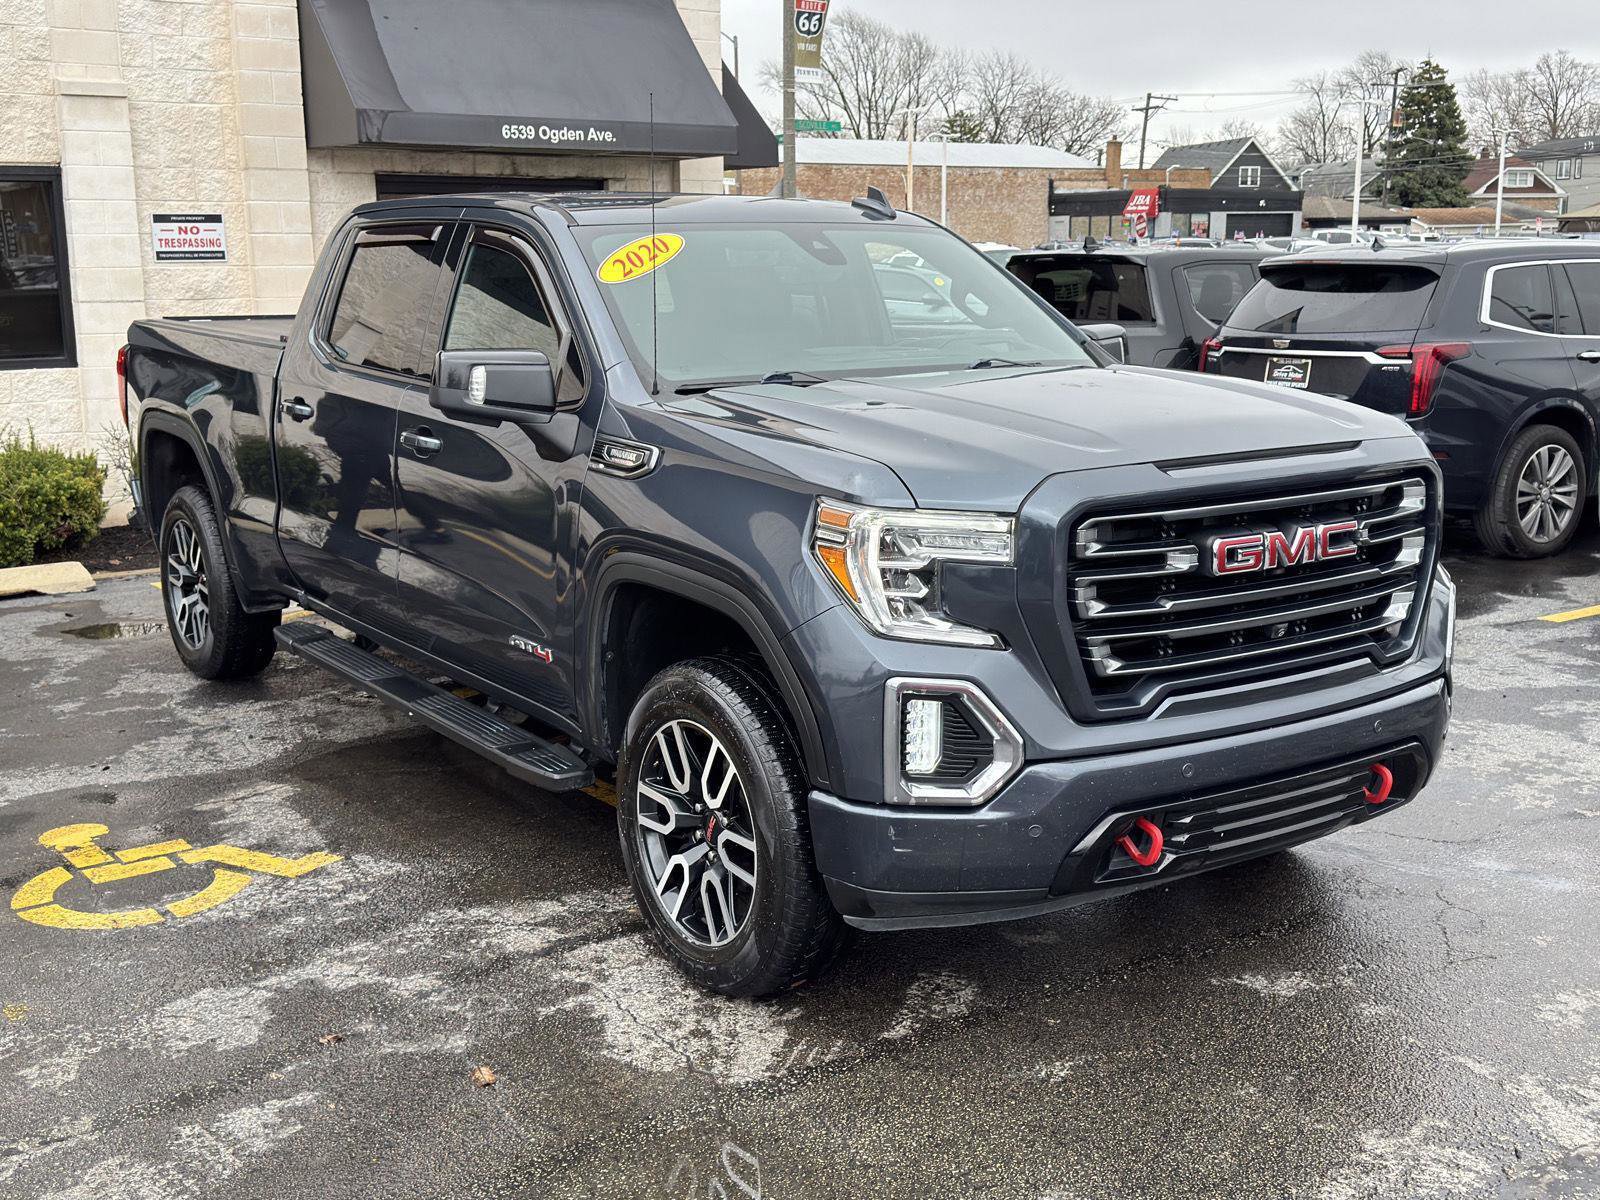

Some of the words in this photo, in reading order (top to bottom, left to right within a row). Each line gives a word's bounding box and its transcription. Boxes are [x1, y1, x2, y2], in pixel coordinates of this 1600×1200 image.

[801, 1, 822, 10] ROUTE
[798, 13, 820, 32] 66
[502, 124, 535, 139] 6539
[539, 125, 584, 143] Ogden
[587, 127, 616, 142] Ave.
[178, 226, 200, 235] NO
[158, 238, 222, 248] TRESPASSING
[613, 238, 669, 277] 2020
[1213, 520, 1358, 576] GMC
[509, 634, 552, 664] AT4
